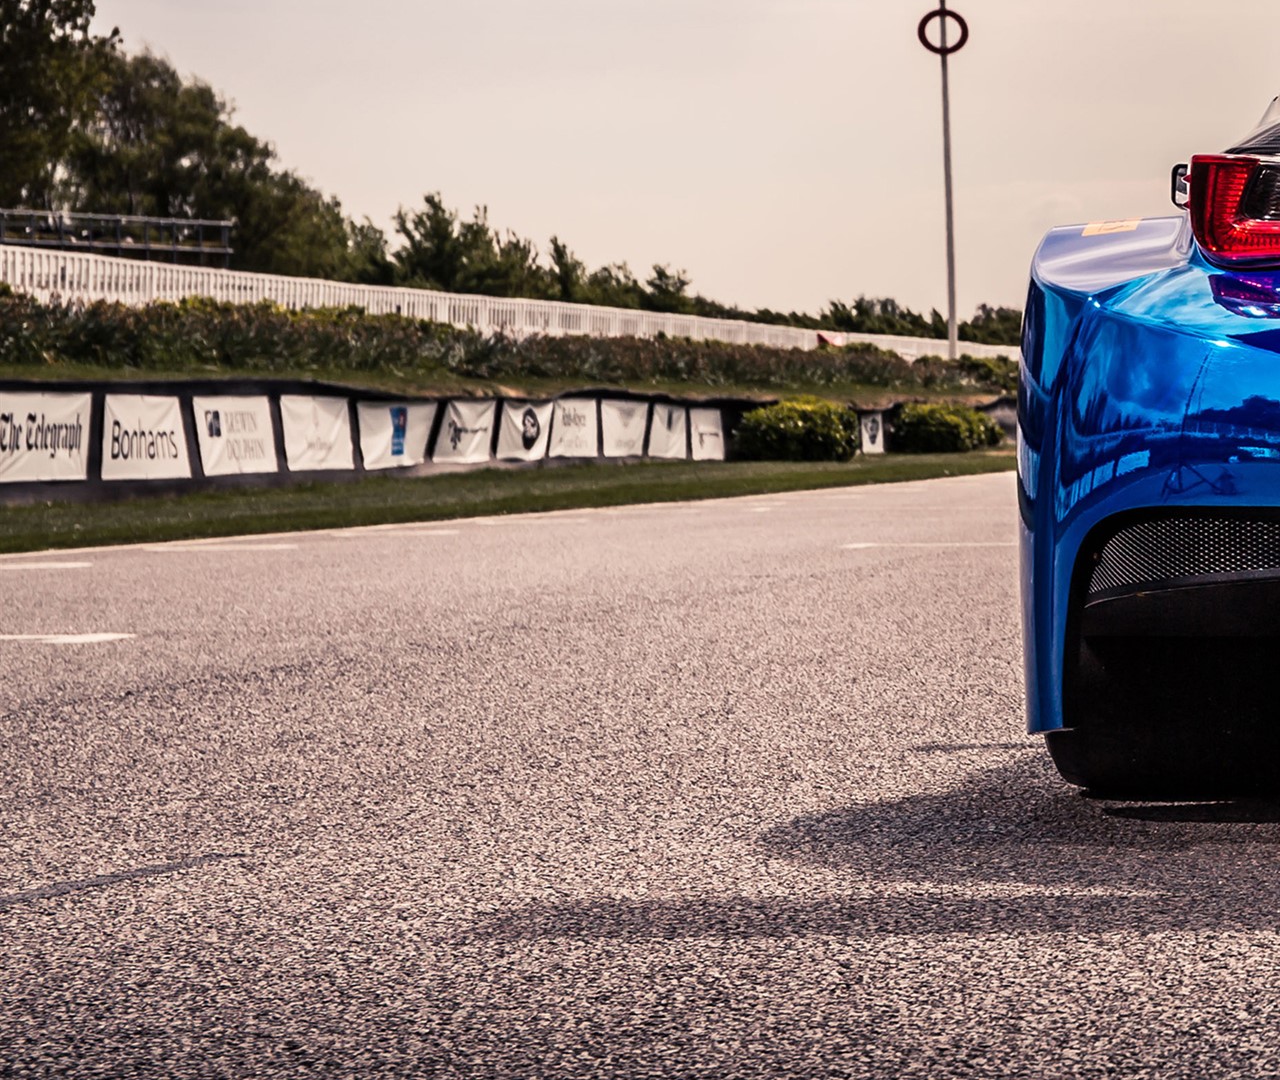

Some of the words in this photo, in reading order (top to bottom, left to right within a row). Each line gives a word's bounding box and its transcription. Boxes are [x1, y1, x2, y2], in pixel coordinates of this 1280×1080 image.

[0, 413, 22, 457] The
[26, 413, 82, 459] Telegraph
[111, 419, 178, 460] Bonhams
